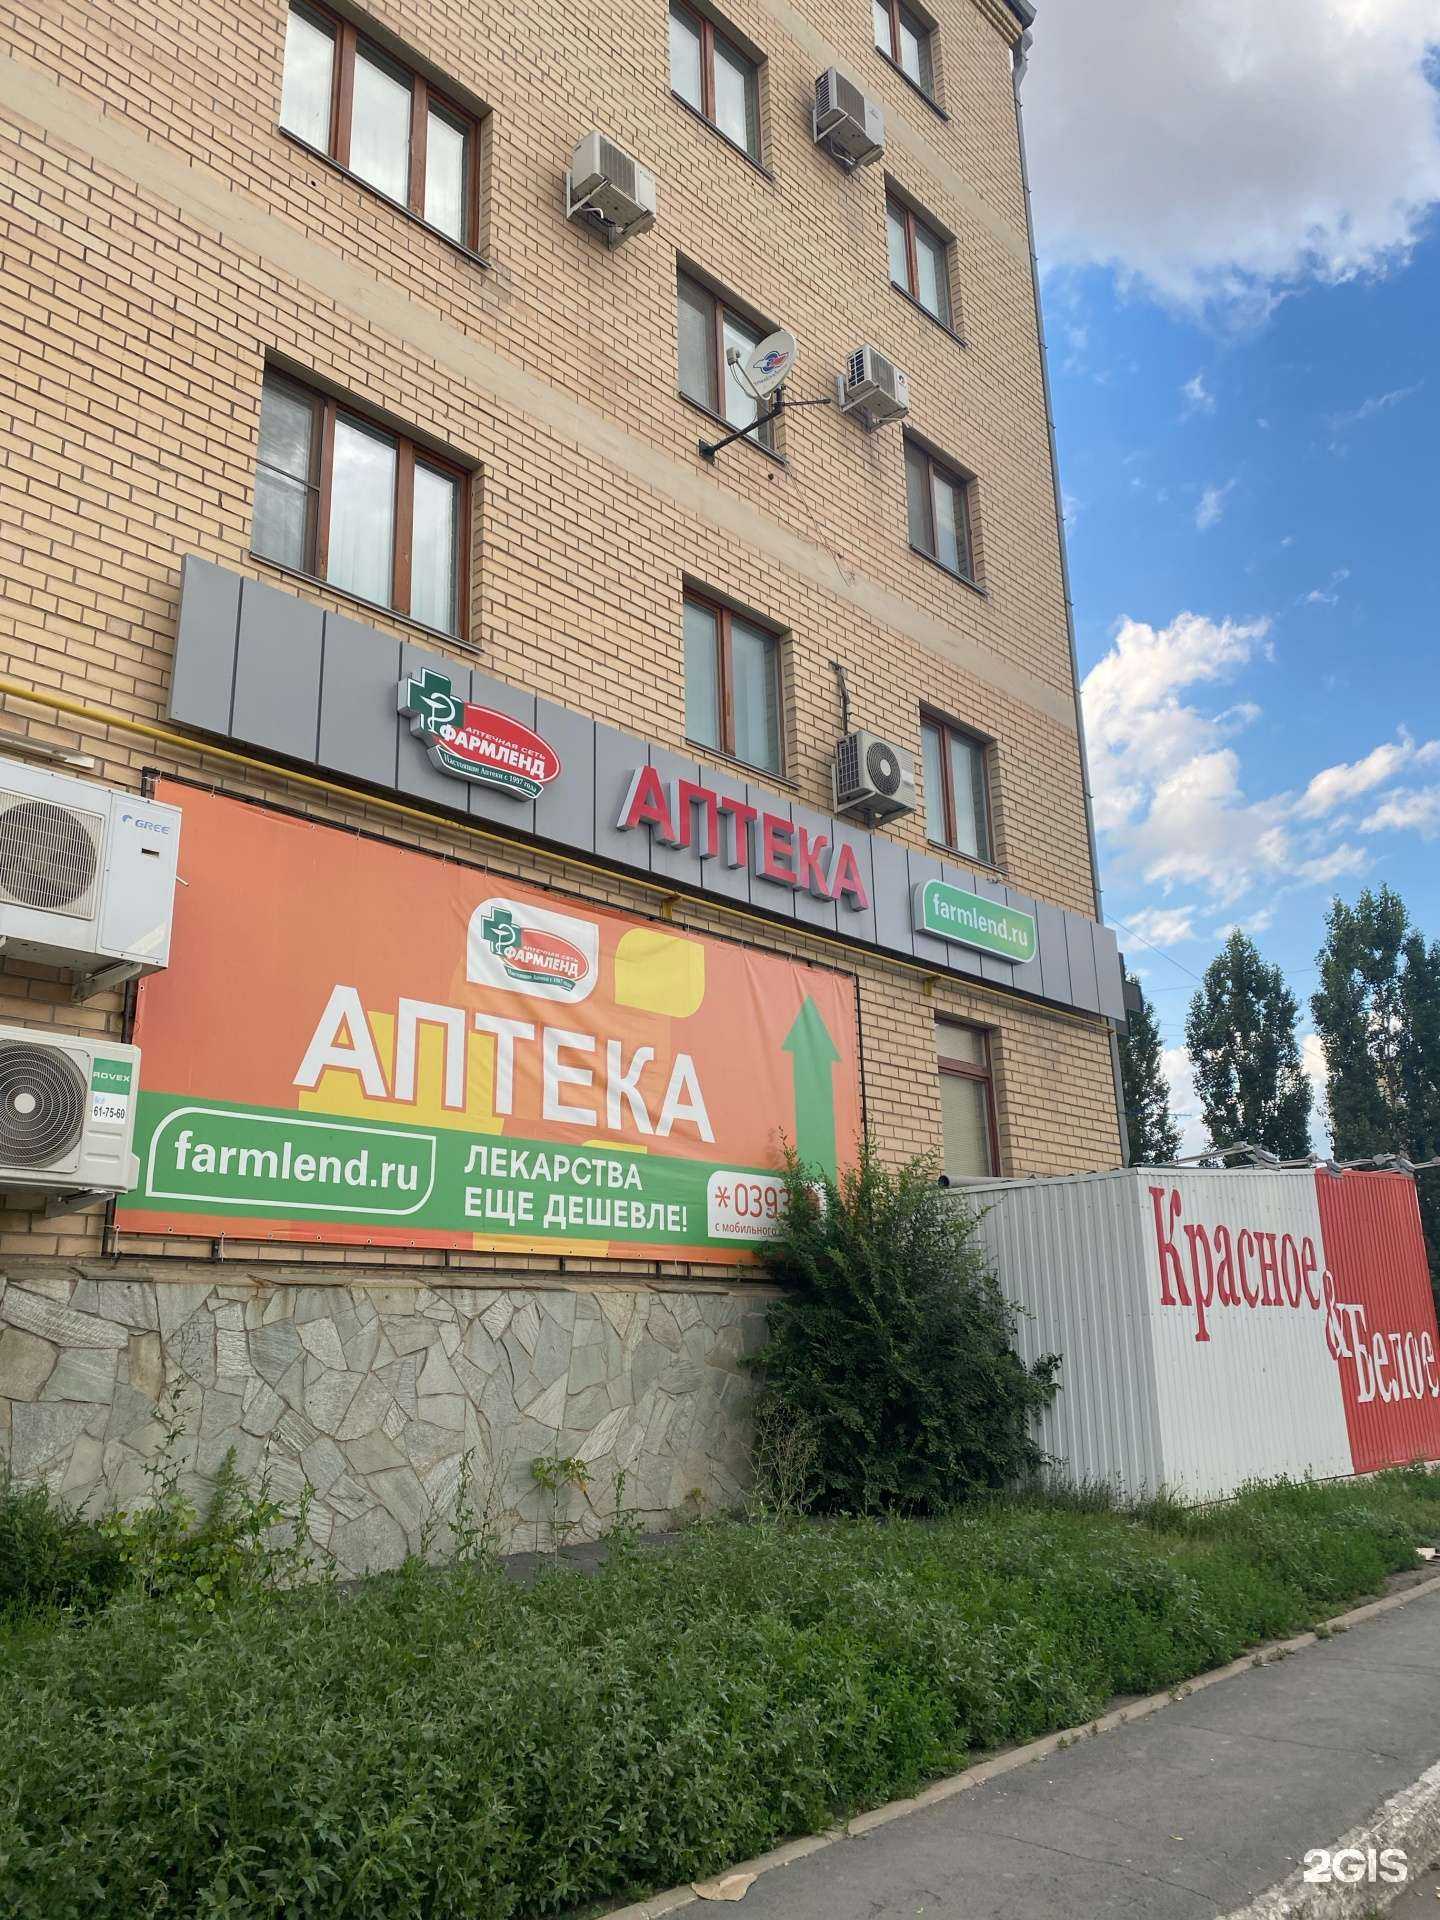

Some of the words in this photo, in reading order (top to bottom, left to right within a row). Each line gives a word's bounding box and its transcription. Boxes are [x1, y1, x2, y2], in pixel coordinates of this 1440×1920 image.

[440, 723, 545, 779] ФАРМЛЕНД
[465, 727, 518, 750] АПТЕЧНАЯ
[521, 747, 546, 760] СЕТЬ
[135, 819, 171, 835] GREE
[617, 765, 871, 912] АПТЕКА
[932, 893, 1028, 947] farmlend.ru
[504, 946, 579, 977] ФАРМЛЕНД
[93, 1071, 131, 1082] ROVEX
[292, 984, 716, 1143] АПТЕКА
[93, 1105, 126, 1119] 61-75-60
[174, 1130, 418, 1191] farmlend.ru
[464, 1144, 643, 1191] ЛЕКАРСТВА
[464, 1186, 535, 1227] ЕЩЕ
[543, 1194, 688, 1232] ДЕШЕВЛЕ!
[715, 1222, 720, 1232] с
[722, 1222, 777, 1236] мобильного
[1149, 1186, 1321, 1342] Красное
[1344, 1303, 1440, 1403] Белое
